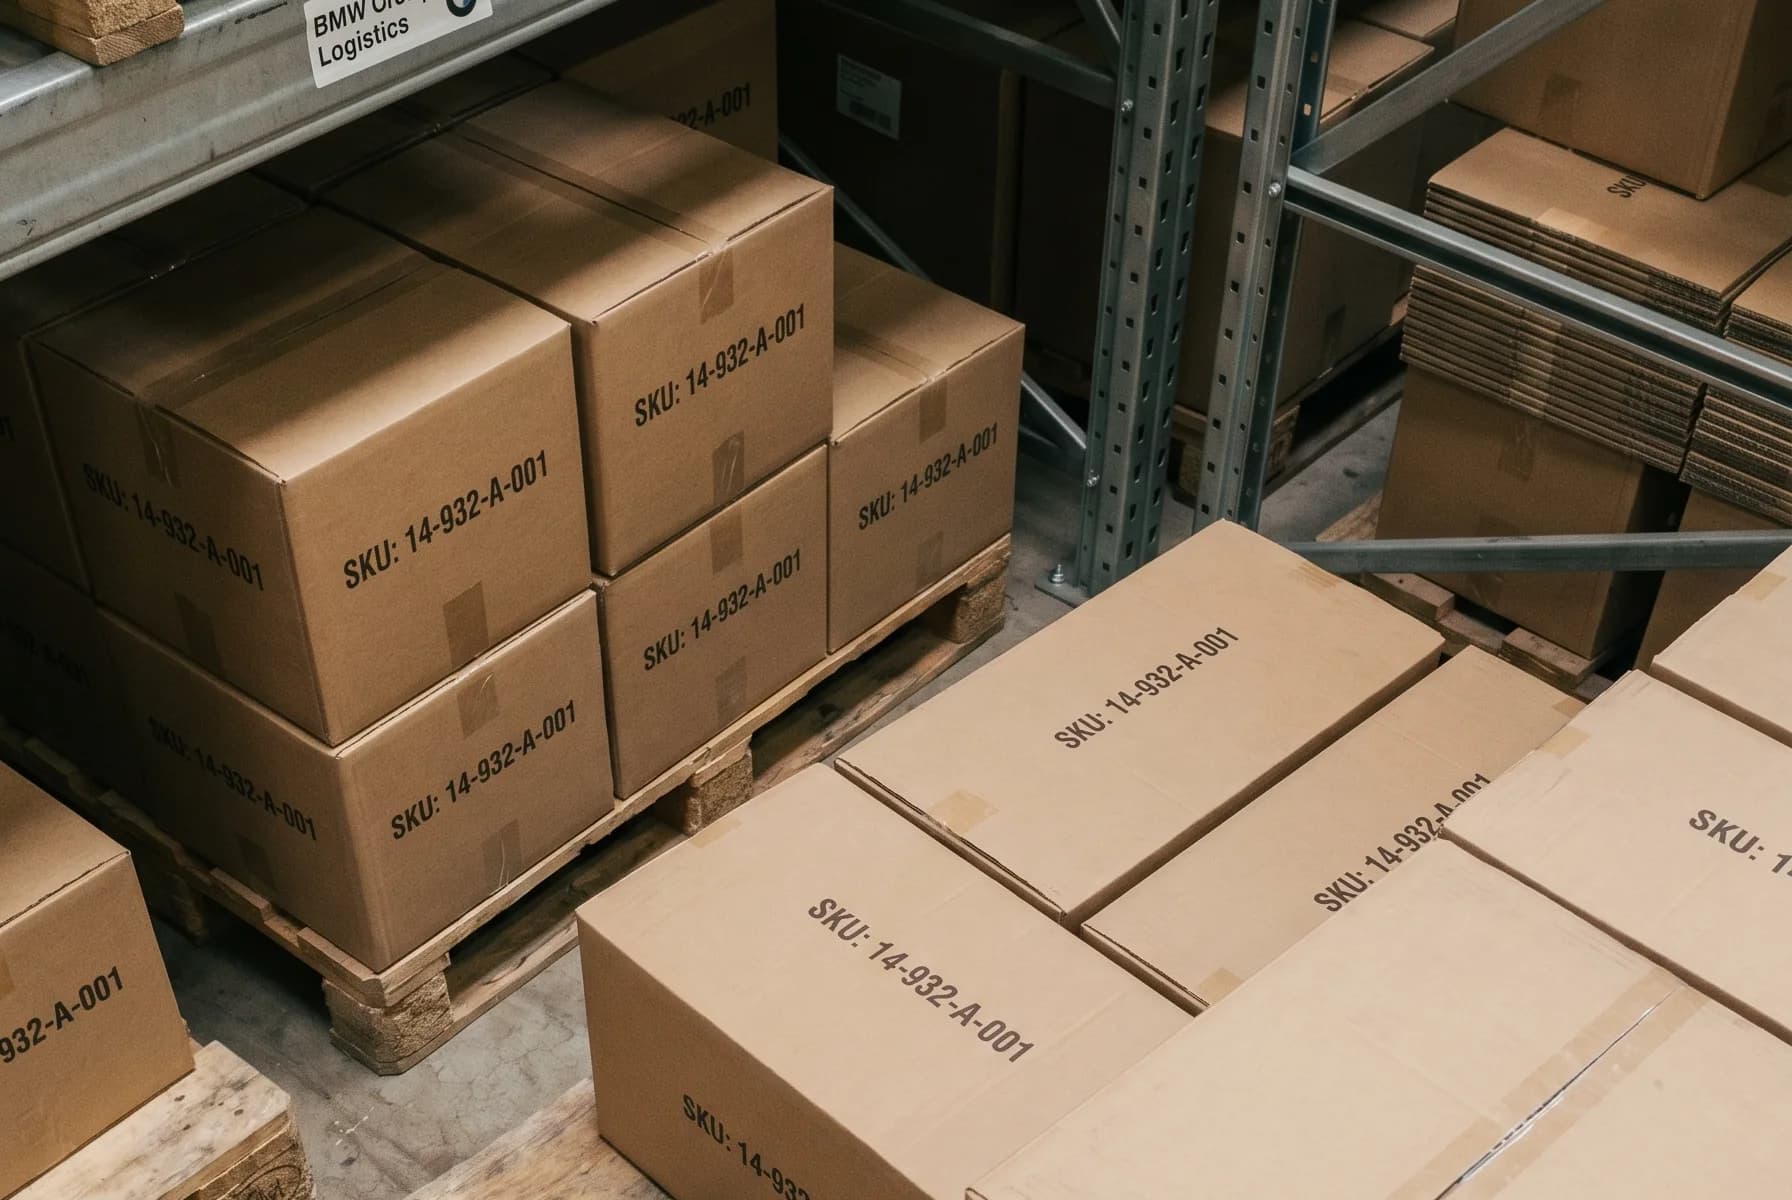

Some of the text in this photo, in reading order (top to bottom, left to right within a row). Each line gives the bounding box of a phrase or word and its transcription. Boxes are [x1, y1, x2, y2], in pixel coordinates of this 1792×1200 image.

[313, 0, 366, 37] BMW
[318, 17, 409, 67] Logistics
[635, 303, 804, 427] SKU: 14-932-A-001
[83, 463, 264, 591] SKU: 14-932-A-001
[344, 450, 547, 590] SKU: 14-932-A-001
[859, 421, 998, 531] SKU: 14-932-A-001
[643, 548, 801, 672] SKU: 14-932-A-001
[1055, 627, 1239, 749] SKU: 14-932-A-001
[391, 700, 576, 840] SKU: 14-932-A-001
[1313, 872, 1375, 912] SKU:
[1688, 809, 1765, 861] SKU:
[0, 965, 123, 1063] 932-A-001
[808, 899, 1035, 1062] SKU: 14-932-A-001
[683, 1094, 731, 1152] SKU:
